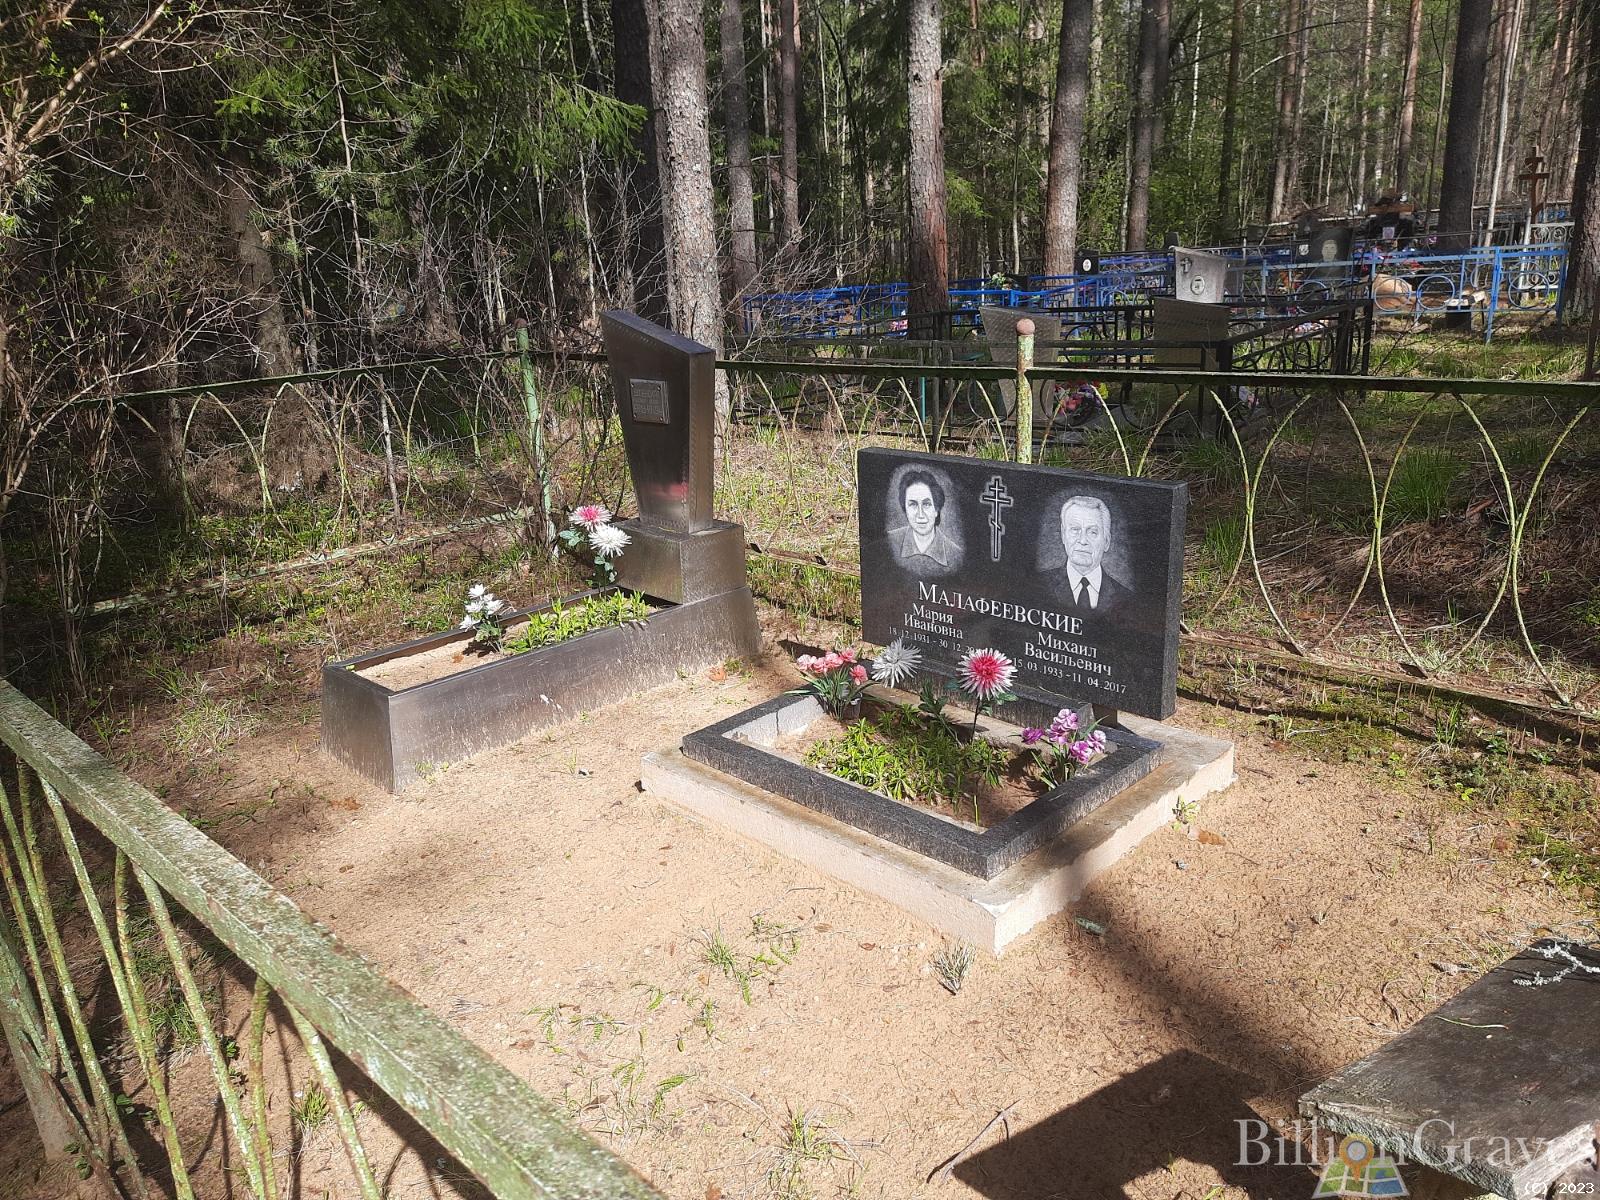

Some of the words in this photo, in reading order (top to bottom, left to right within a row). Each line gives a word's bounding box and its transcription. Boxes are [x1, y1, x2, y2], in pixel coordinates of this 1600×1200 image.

[903, 613, 963, 639] Ивановна
[912, 603, 954, 626] Мария
[1037, 631, 1098, 658] Михаил
[1024, 641, 1112, 676] Васильевич
